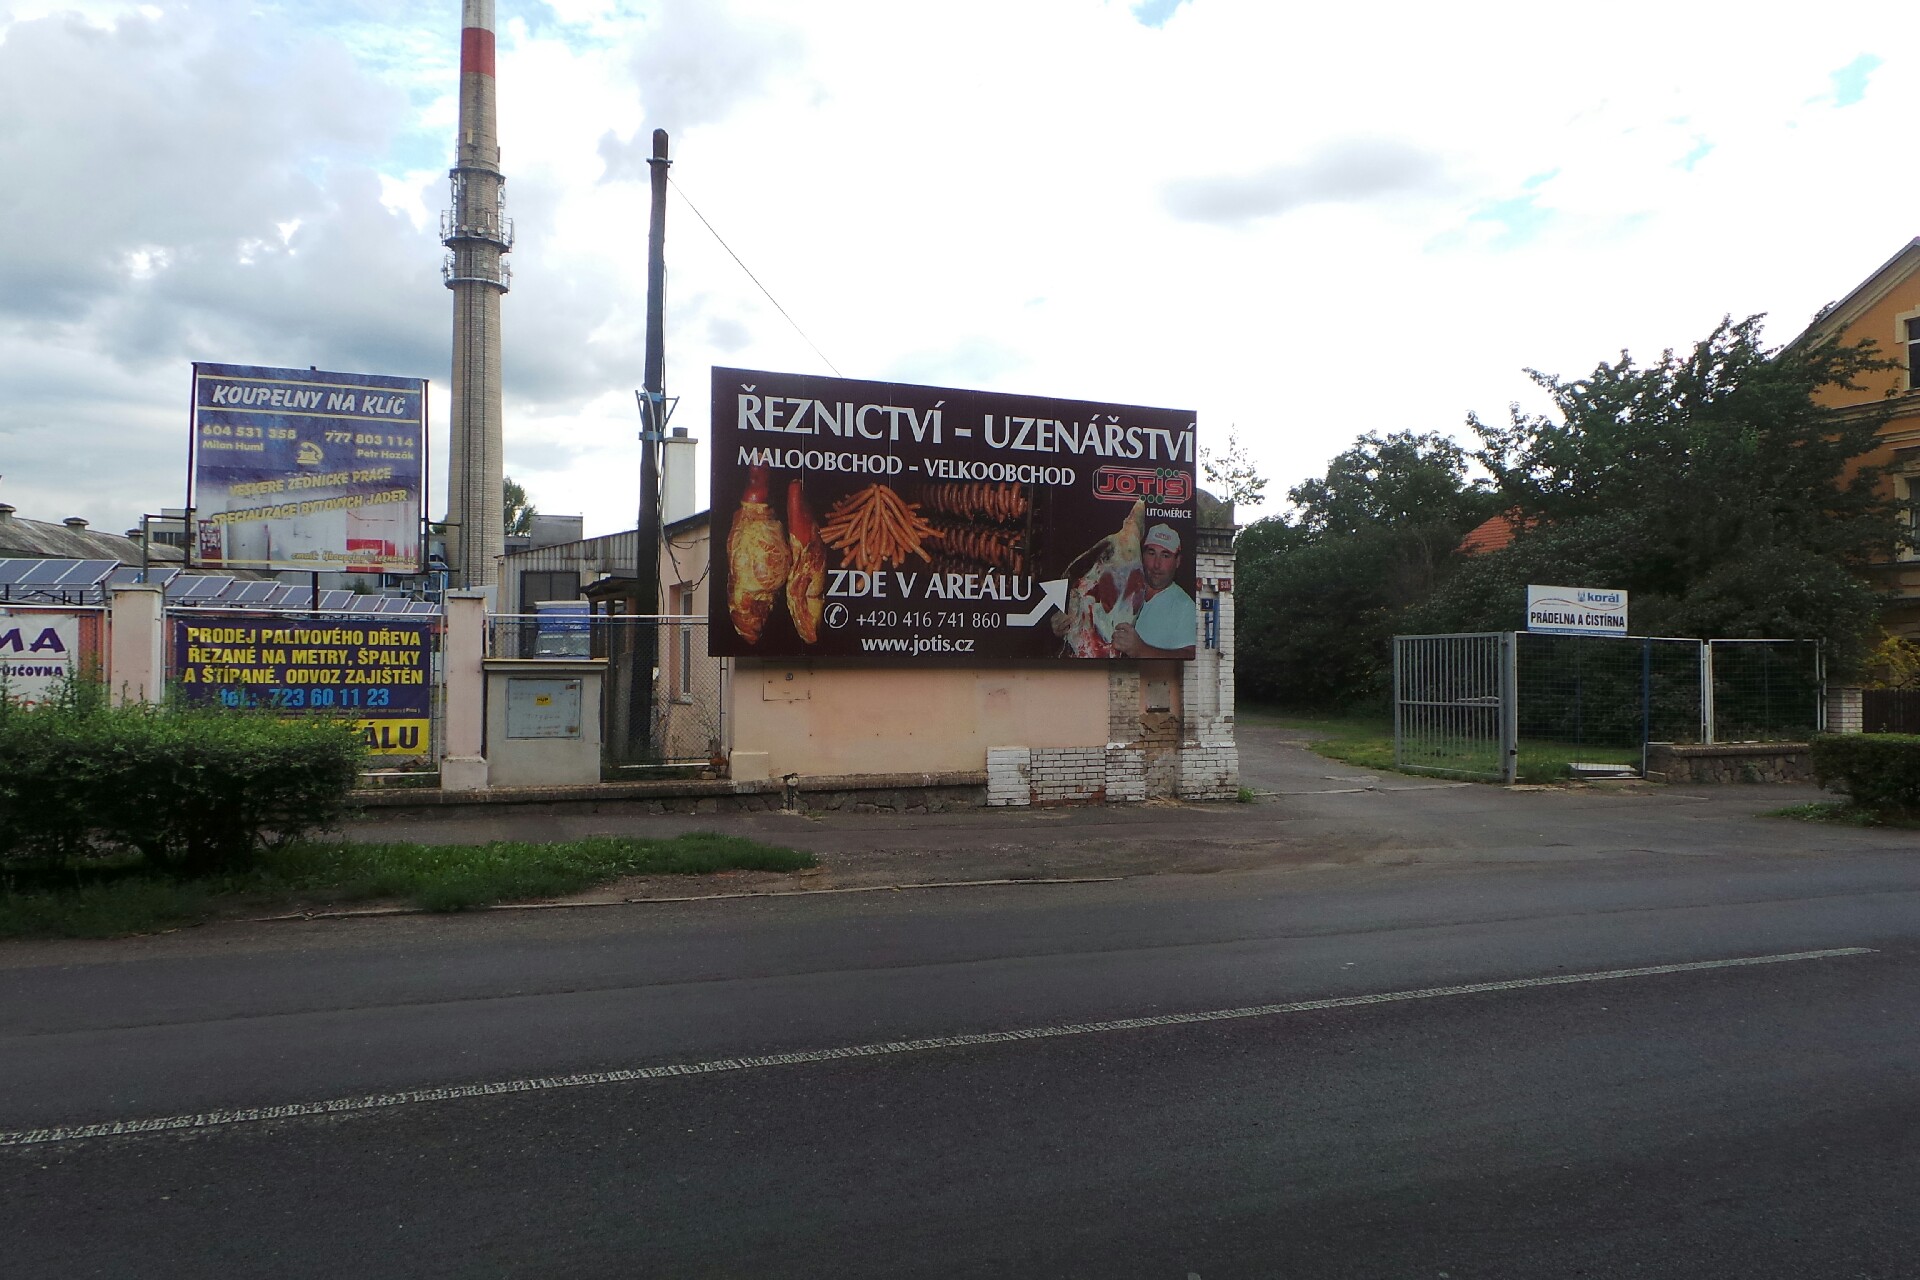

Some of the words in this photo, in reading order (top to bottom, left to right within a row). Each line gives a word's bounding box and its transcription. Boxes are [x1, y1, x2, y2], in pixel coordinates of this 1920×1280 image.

[212, 385, 323, 409] KOUPELNY
[327, 392, 355, 412] NA
[361, 396, 406, 415] KLÍČ
[203, 424, 232, 436] 604
[236, 426, 263, 438] 531
[268, 428, 297, 440] 358
[738, 383, 946, 444] ŘEZNICTVÍ
[984, 413, 1196, 463] UZENÁŘSTVÍ
[325, 431, 352, 443] 777
[356, 433, 382, 445] 803
[388, 435, 414, 447] 114
[357, 448, 378, 458] Petr
[737, 446, 903, 475] MALOOBCHOD
[924, 458, 1076, 487] VELKOOBCHOD
[210, 502, 298, 527] SPECIALIZACE
[366, 489, 408, 506] JADER
[1146, 507, 1192, 519] LITOMĚŘICE
[826, 569, 887, 597] ZDE
[895, 572, 918, 599] V
[924, 567, 1033, 601] AREÁLU
[1587, 592, 1620, 603] korál
[856, 610, 898, 628] +420
[902, 611, 933, 628] 416
[937, 612, 966, 628] 741
[972, 612, 1001, 629] 860
[1530, 610, 1576, 625] PRÁDELNA
[1577, 614, 1584, 626] A
[1586, 612, 1625, 627] ČISTÍRNA
[187, 627, 256, 644] PRODEJ
[261, 627, 364, 645] PALIVOVÉHO
[368, 627, 421, 646] DŘEVA
[861, 634, 975, 656] www.jotis.cz
[188, 644, 256, 664] ŘEZANÉ
[262, 649, 286, 664] NA
[291, 649, 353, 666] METRY,
[357, 647, 421, 665] ŠPALKY
[183, 668, 197, 683] A
[202, 664, 280, 684] ŠTÍPANÉ.
[286, 669, 341, 684] ODVOZ
[345, 667, 423, 684] ZAJIŠTĚN
[268, 688, 305, 707] 723
[310, 688, 334, 706] 60
[340, 688, 359, 706] 11
[367, 688, 389, 706] 23
